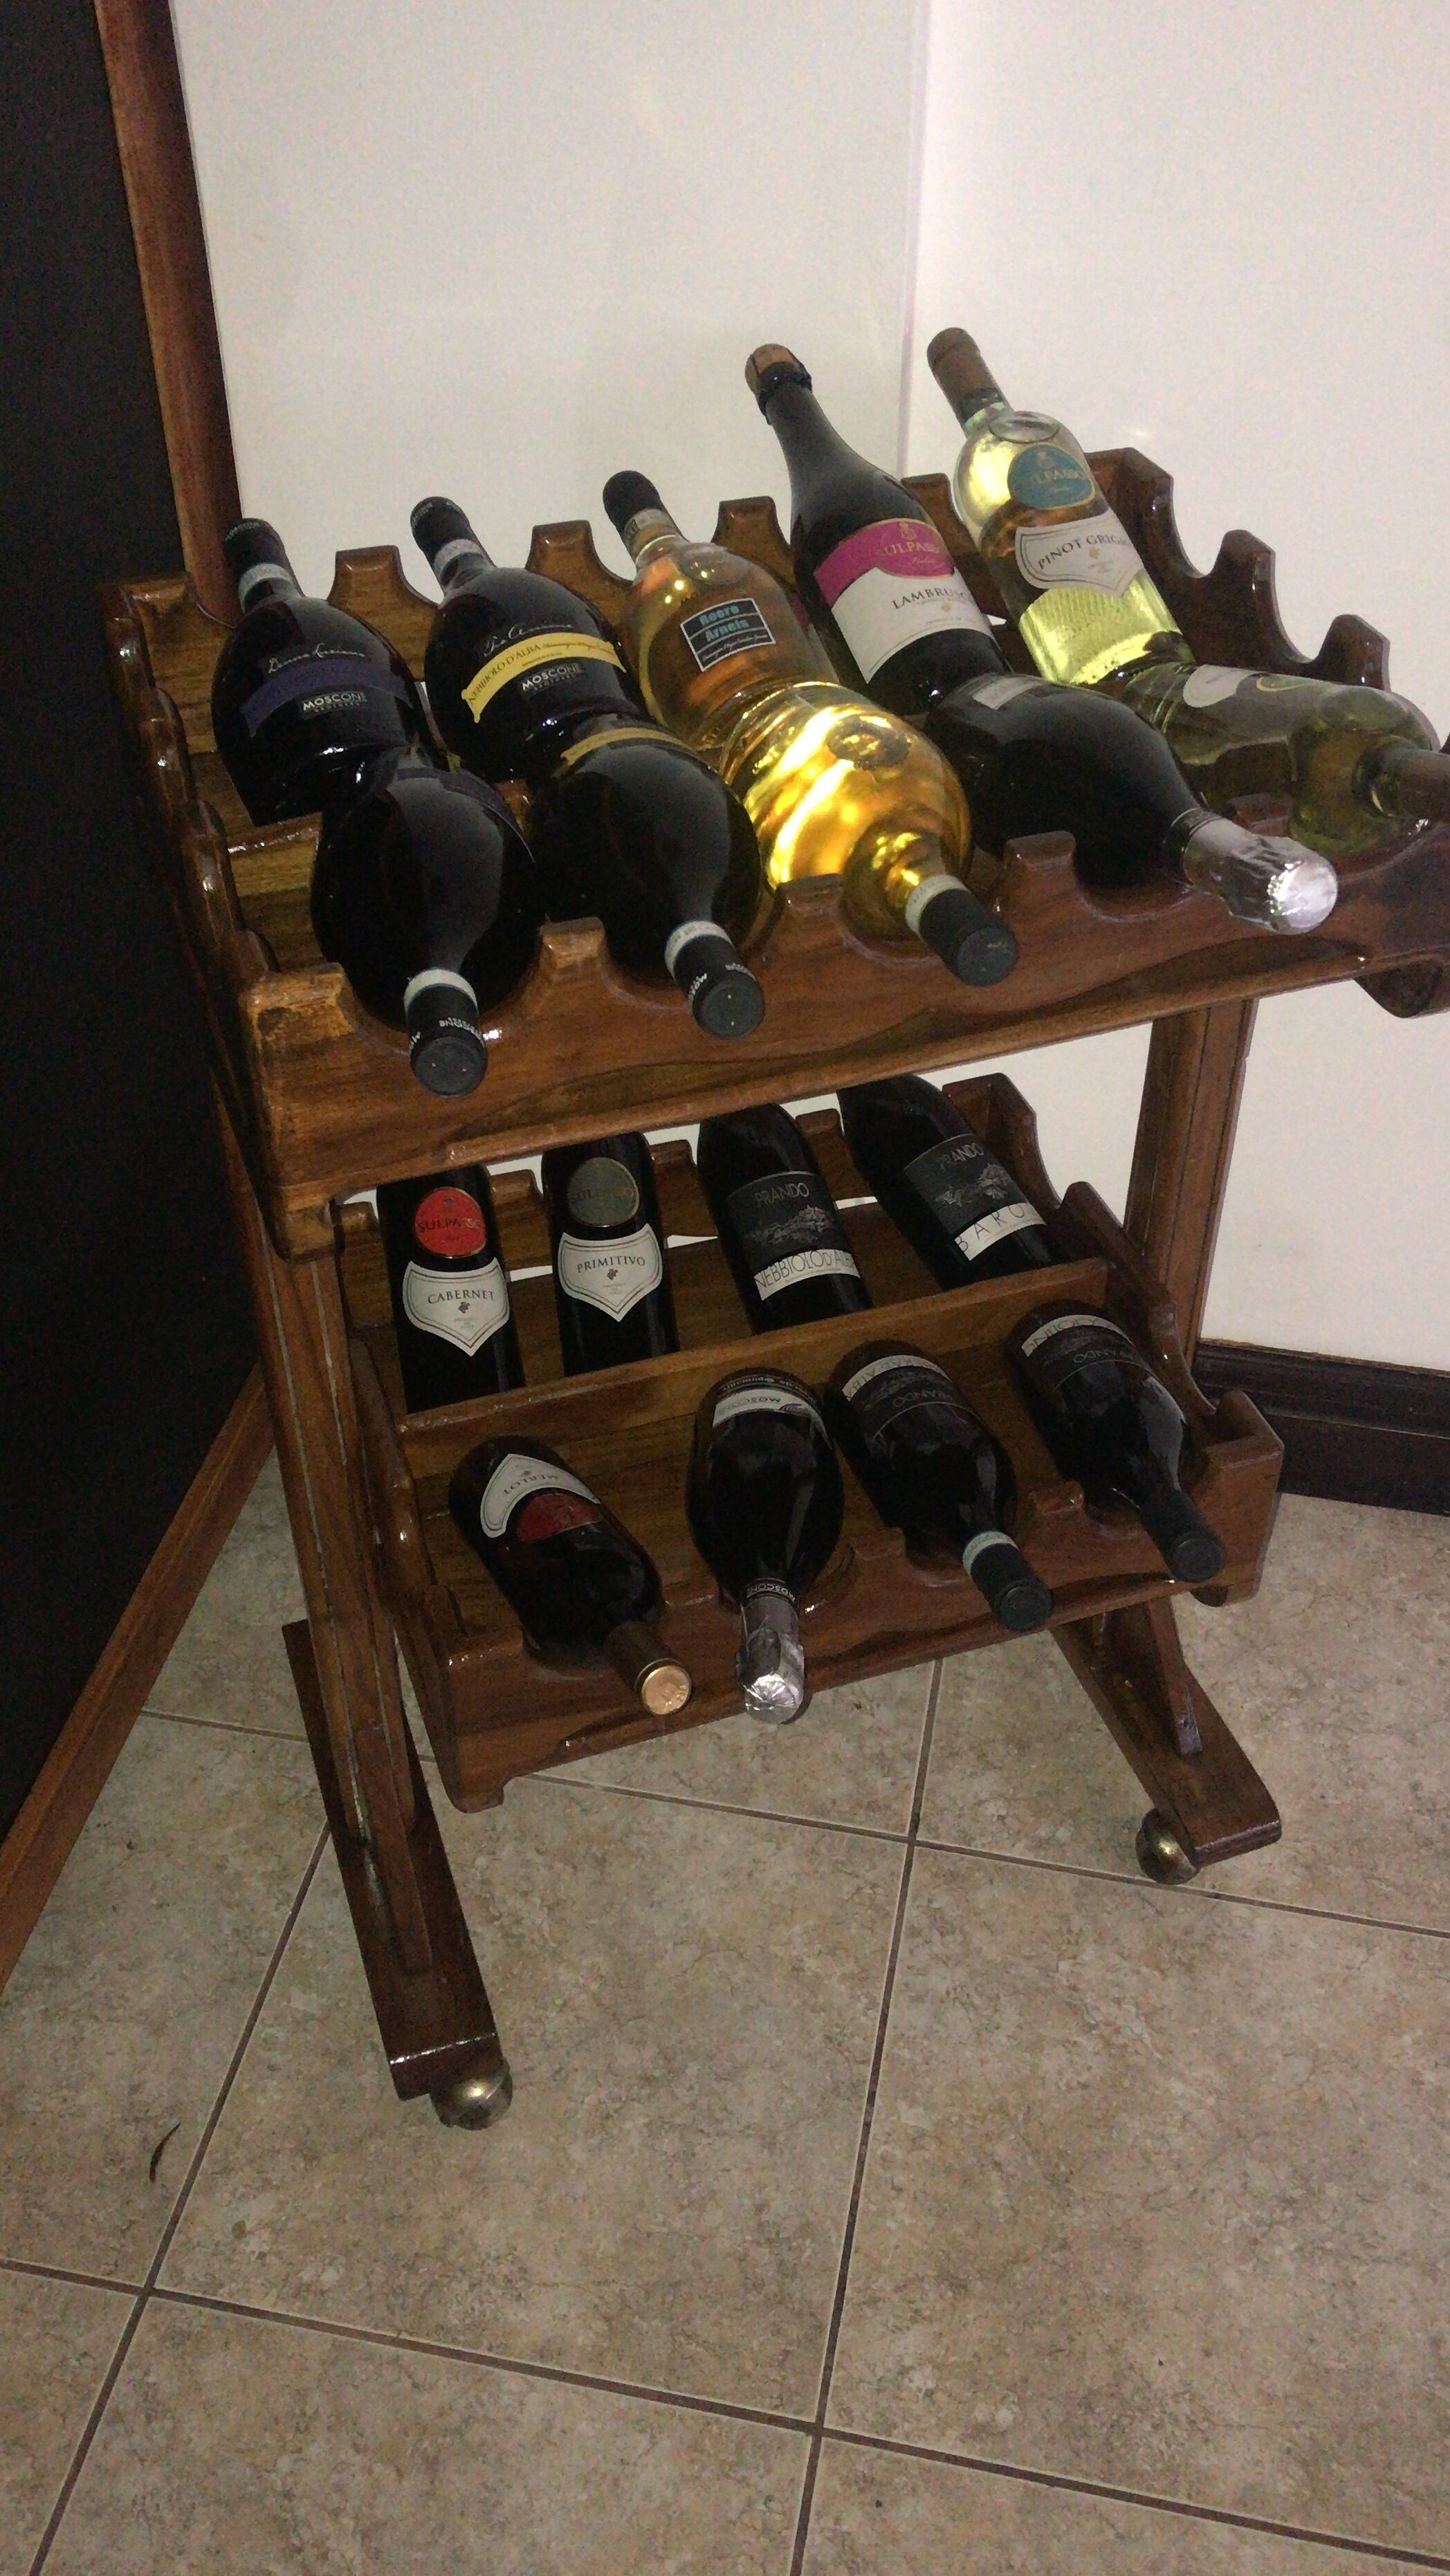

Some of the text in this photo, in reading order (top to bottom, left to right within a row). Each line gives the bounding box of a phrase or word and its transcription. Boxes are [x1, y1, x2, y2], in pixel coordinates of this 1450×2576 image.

[1037, 538, 1082, 570] PINOT
[891, 587, 967, 609] LAMBRUSC
[754, 1182, 816, 1208] PRANDO
[577, 1255, 646, 1273] PRIMITIVO
[753, 1250, 825, 1289] NEBBIOLO
[427, 1289, 495, 1305] CABERNET
